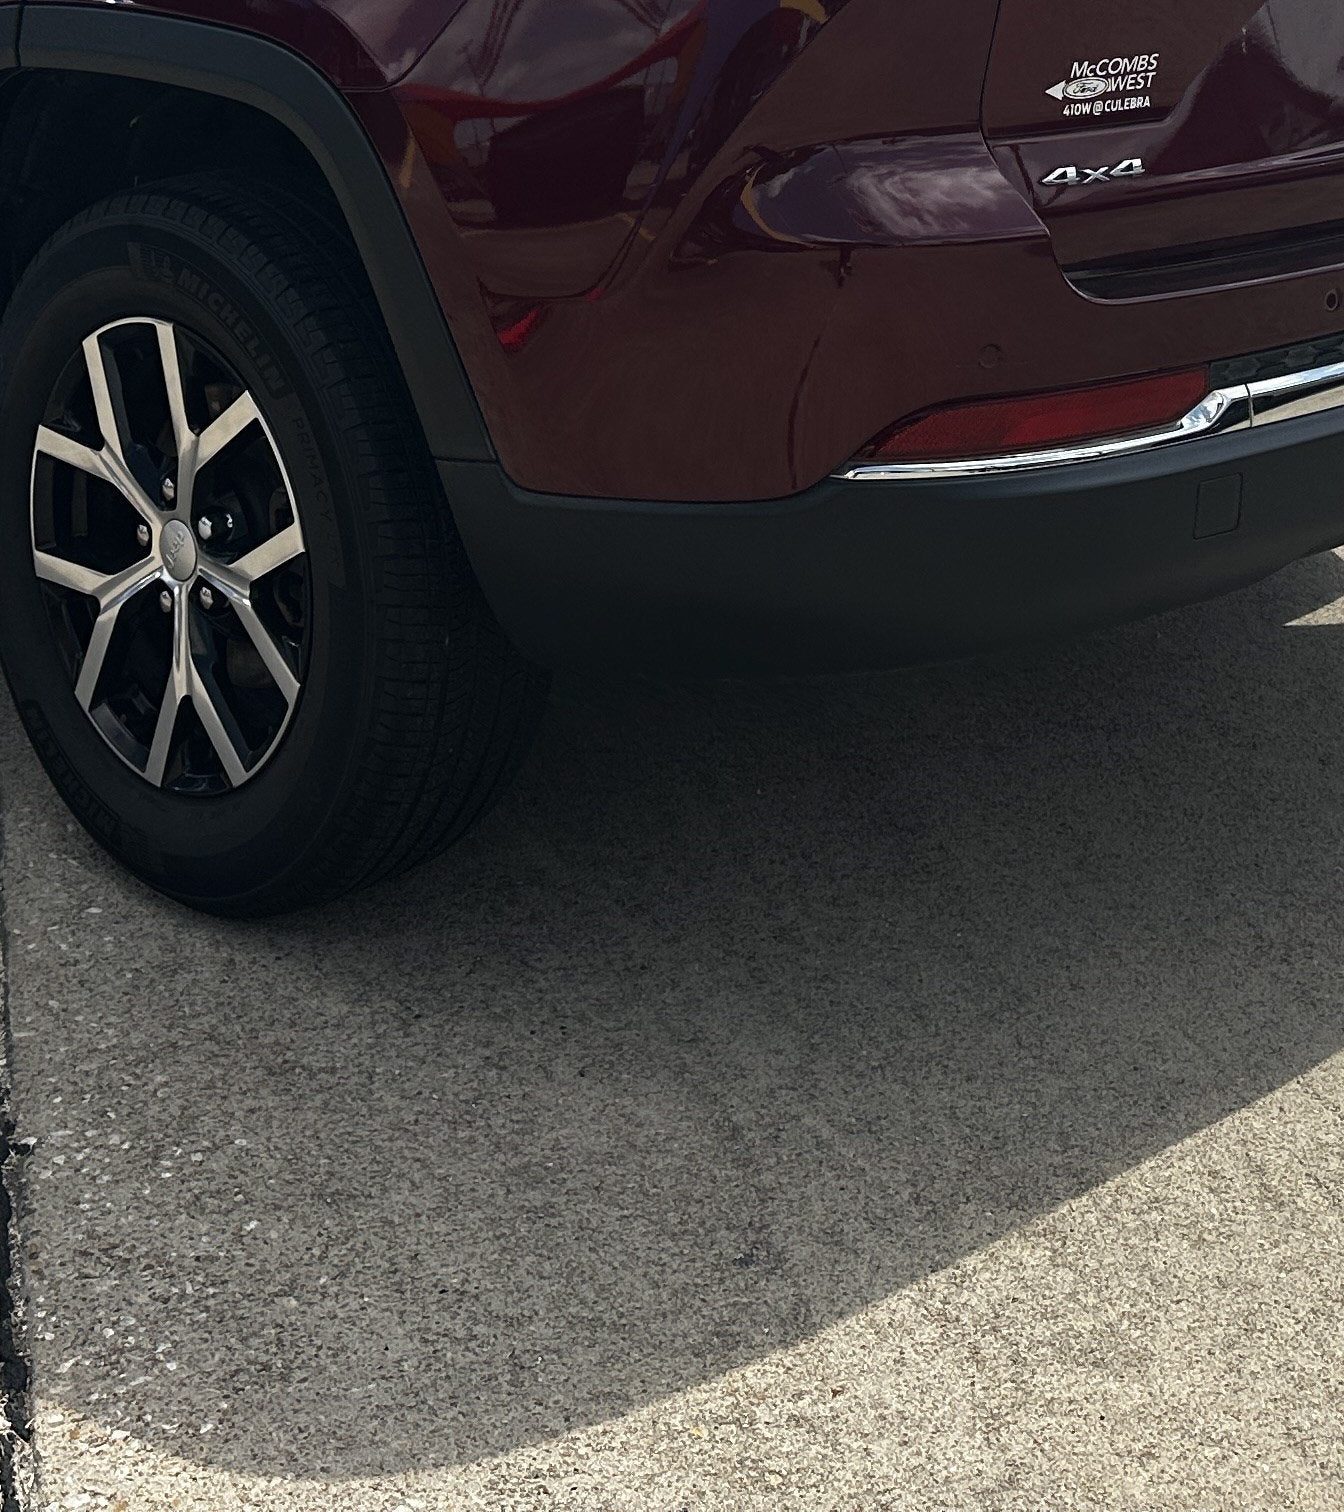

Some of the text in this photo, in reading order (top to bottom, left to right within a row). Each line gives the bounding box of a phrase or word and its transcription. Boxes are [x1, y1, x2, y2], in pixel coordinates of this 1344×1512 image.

[1070, 53, 1159, 79] McCOMBS
[1107, 72, 1157, 93] WEST
[177, 266, 288, 395] MICHELIN
[292, 416, 333, 522] PRIMACY
